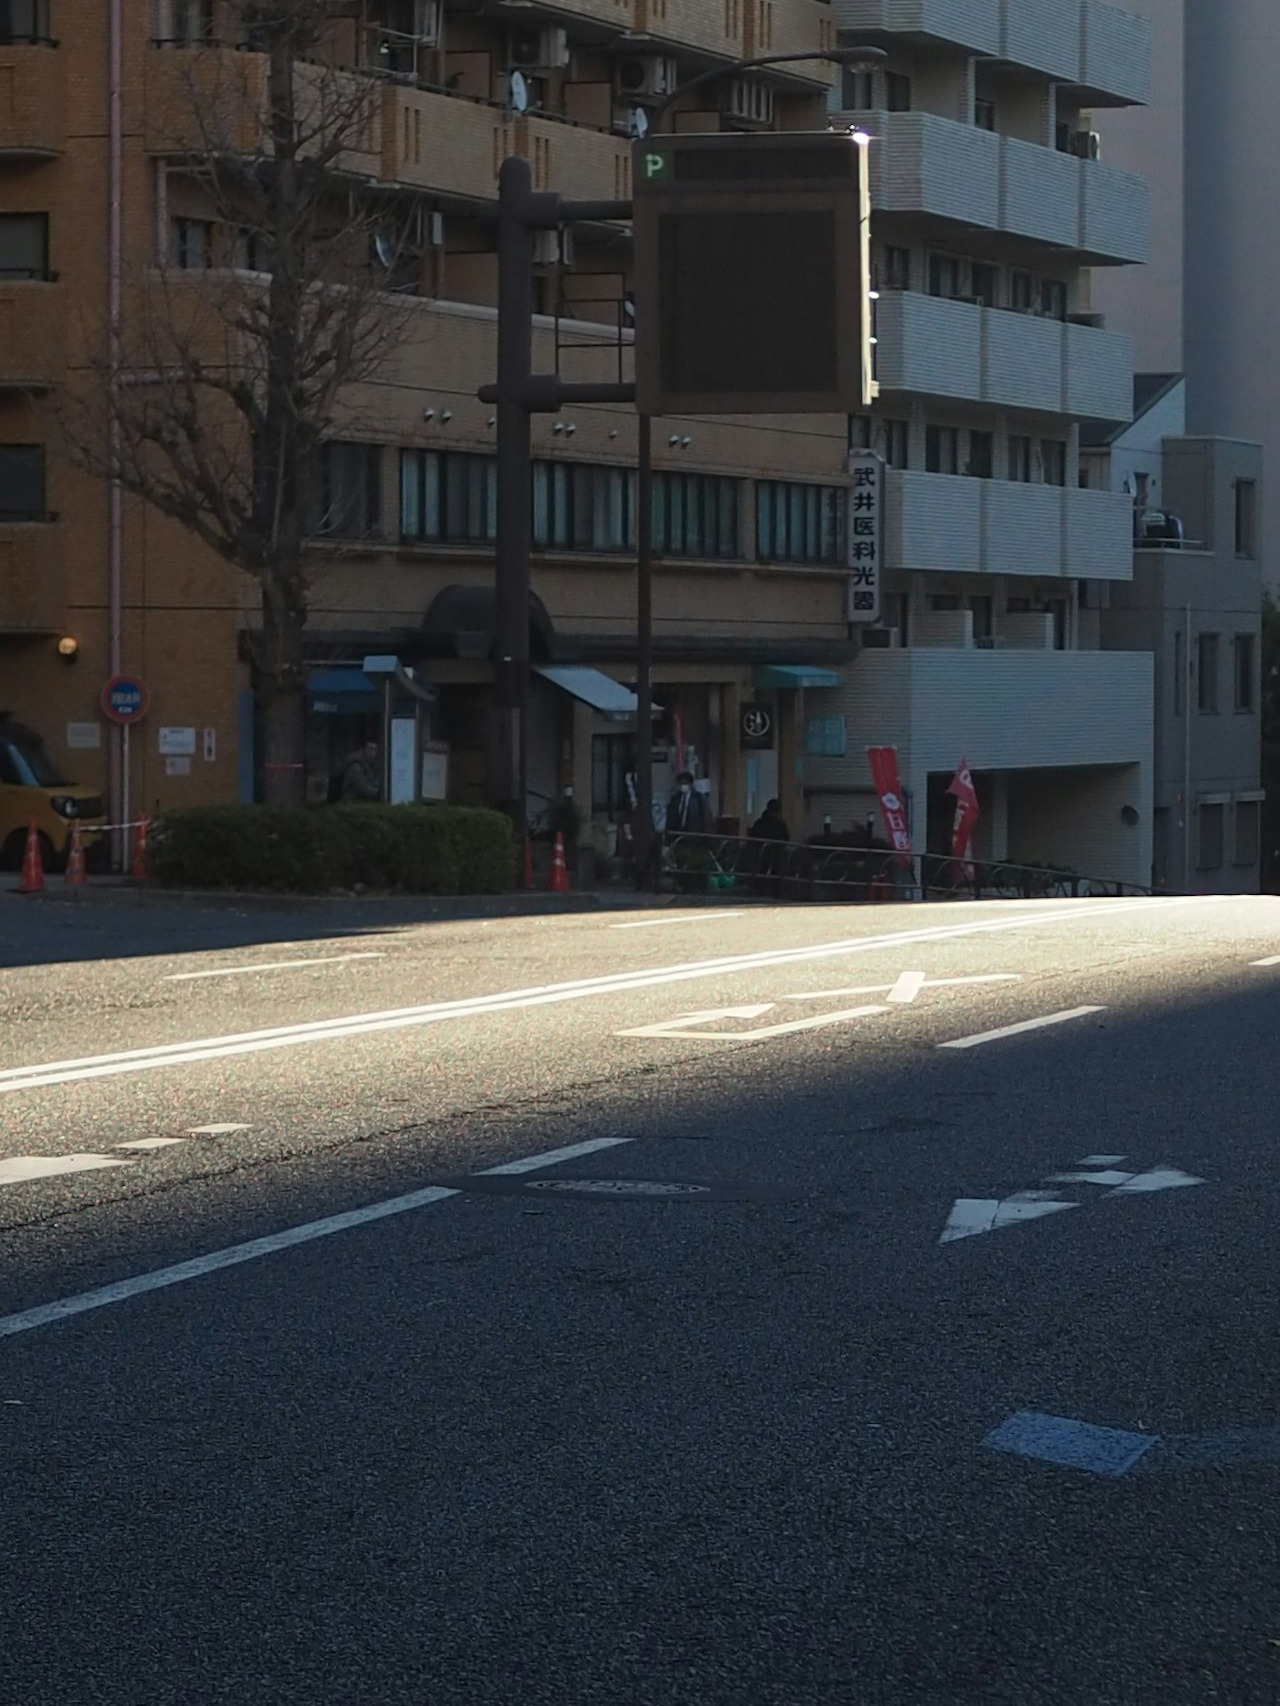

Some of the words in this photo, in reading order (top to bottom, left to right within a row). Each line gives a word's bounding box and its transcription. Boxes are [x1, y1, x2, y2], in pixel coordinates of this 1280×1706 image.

[853, 467, 876, 610] 武井医科光器
